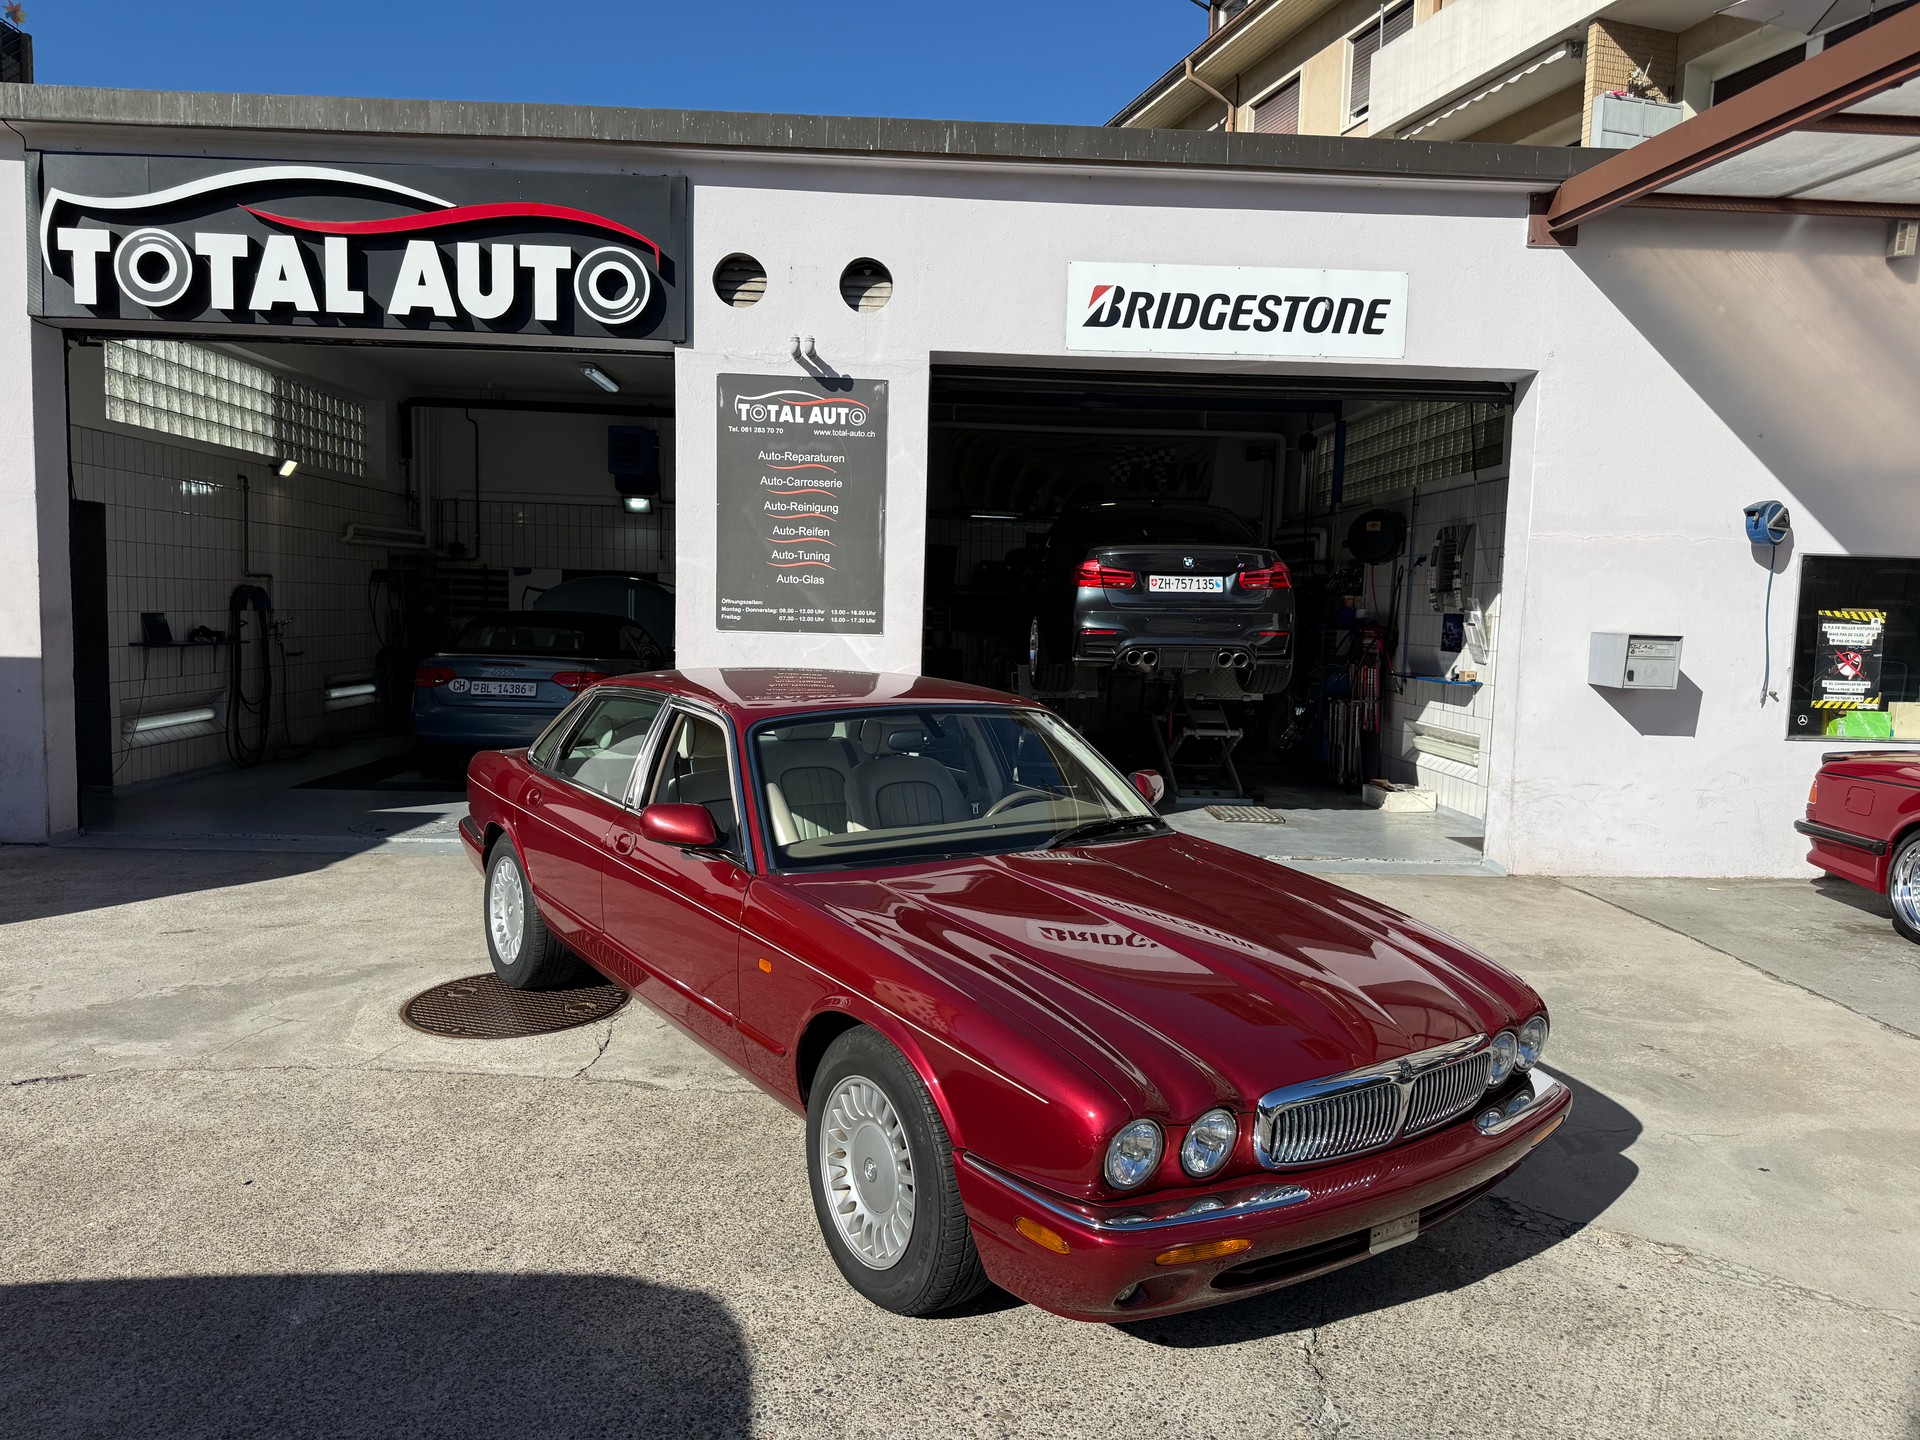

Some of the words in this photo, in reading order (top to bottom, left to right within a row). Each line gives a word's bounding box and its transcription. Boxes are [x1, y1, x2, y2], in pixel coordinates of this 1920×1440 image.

[57, 227, 364, 314] TOTAL
[387, 240, 651, 325] AUTO
[1082, 285, 1391, 335] BRIDGESTONE
[738, 403, 804, 423] TOTAL
[808, 406, 867, 426] AUTO
[728, 425, 739, 433] Tel.
[813, 429, 876, 438] www.total-auto.ch
[758, 451, 845, 463] Auto-Reparaturen
[760, 477, 843, 488] Auto-Carrosserie
[763, 501, 839, 514] Auto-Reinigung
[772, 526, 830, 537] Auto-Reifen
[771, 550, 831, 562] Auto-Tuning
[776, 574, 825, 585] Auto-Glas
[453, 680, 466, 691] CH
